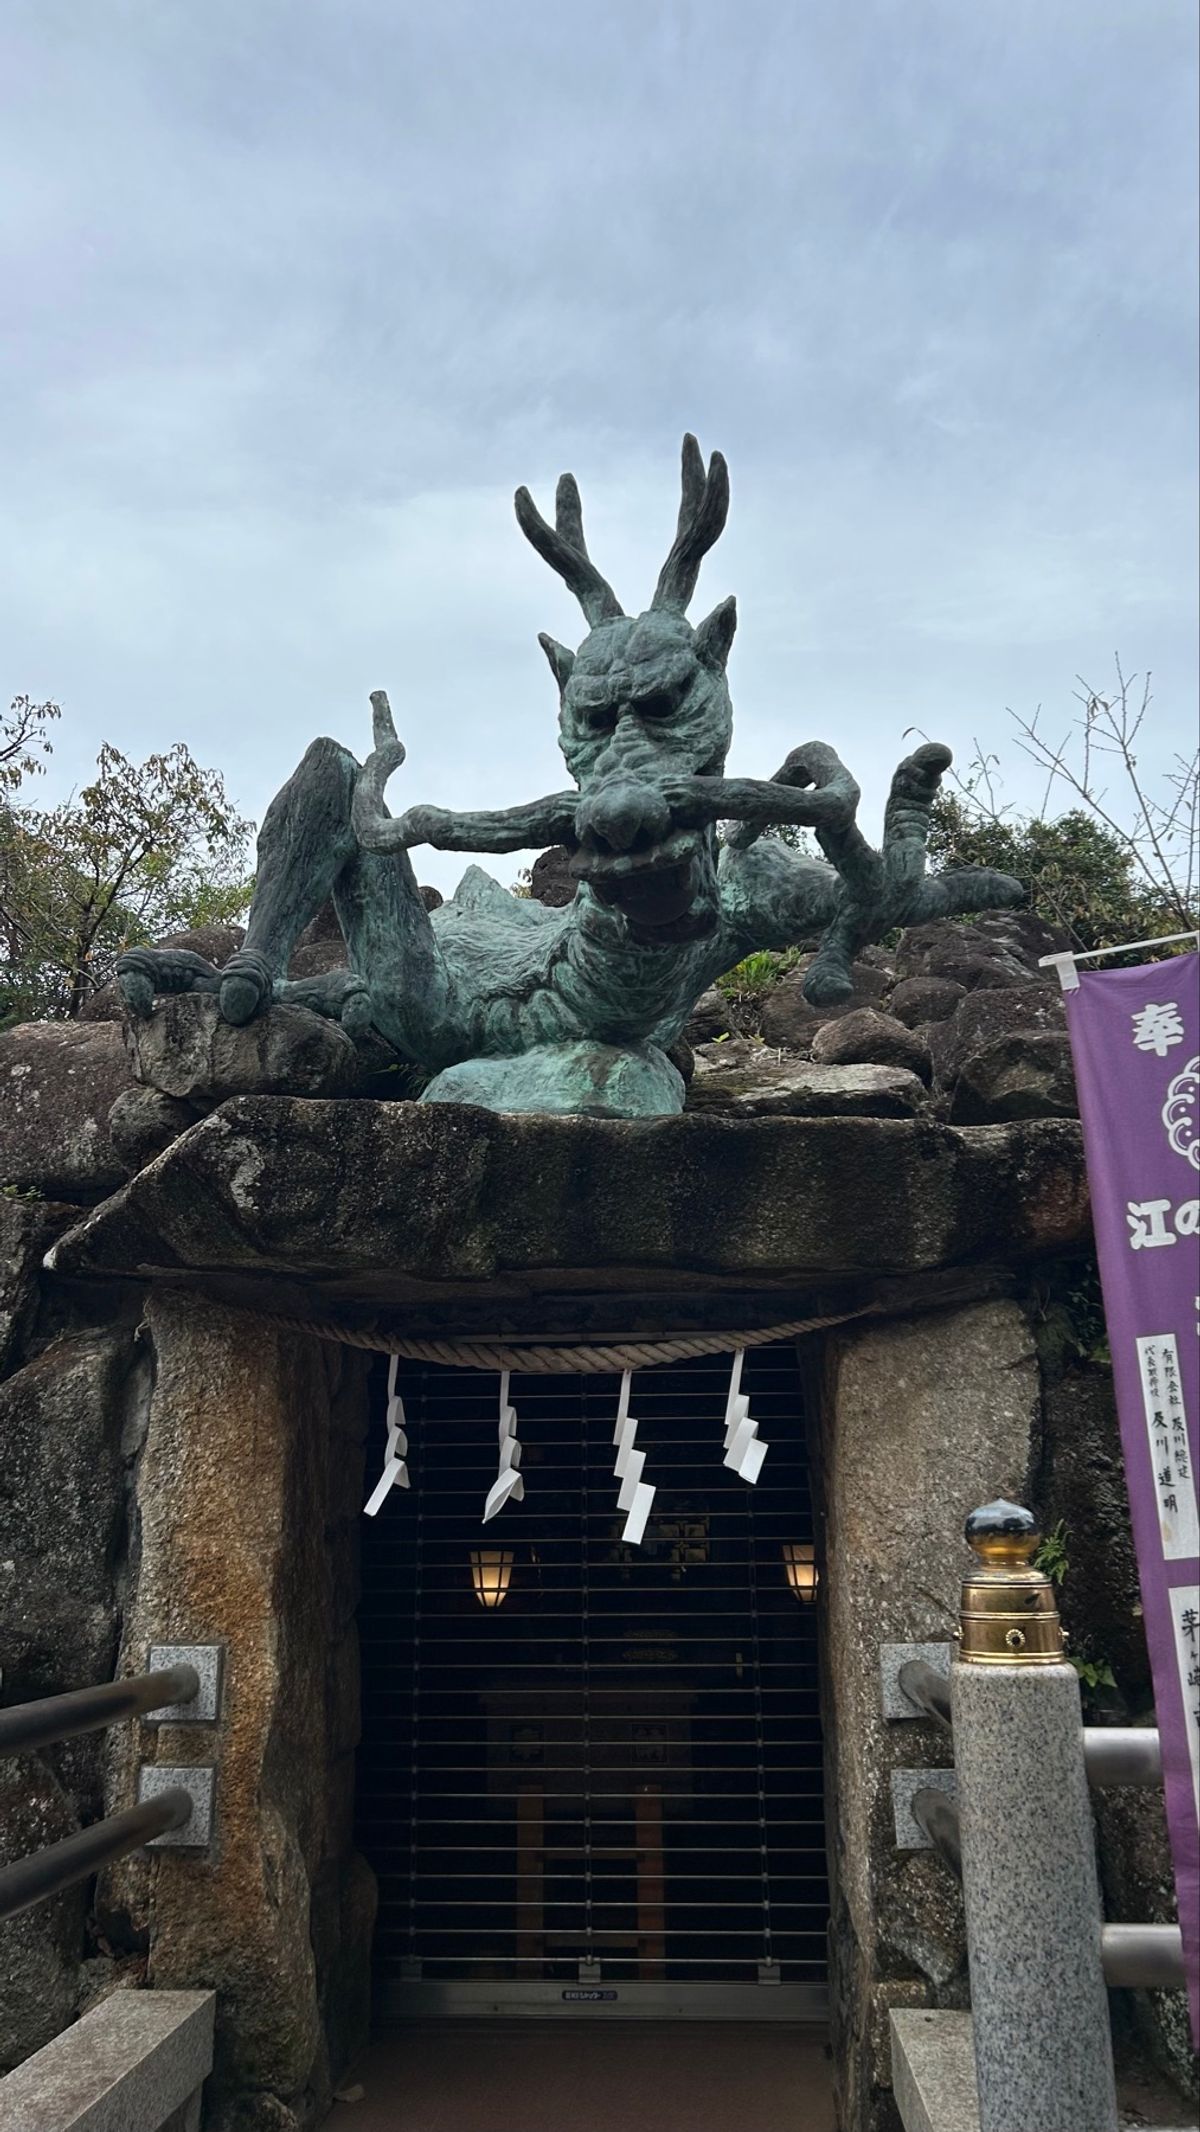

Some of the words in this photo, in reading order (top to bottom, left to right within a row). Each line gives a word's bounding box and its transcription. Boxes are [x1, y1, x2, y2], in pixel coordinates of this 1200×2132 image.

[1131, 1003, 1184, 1056] 奉
[1162, 1348, 1182, 1406] 有限会社
